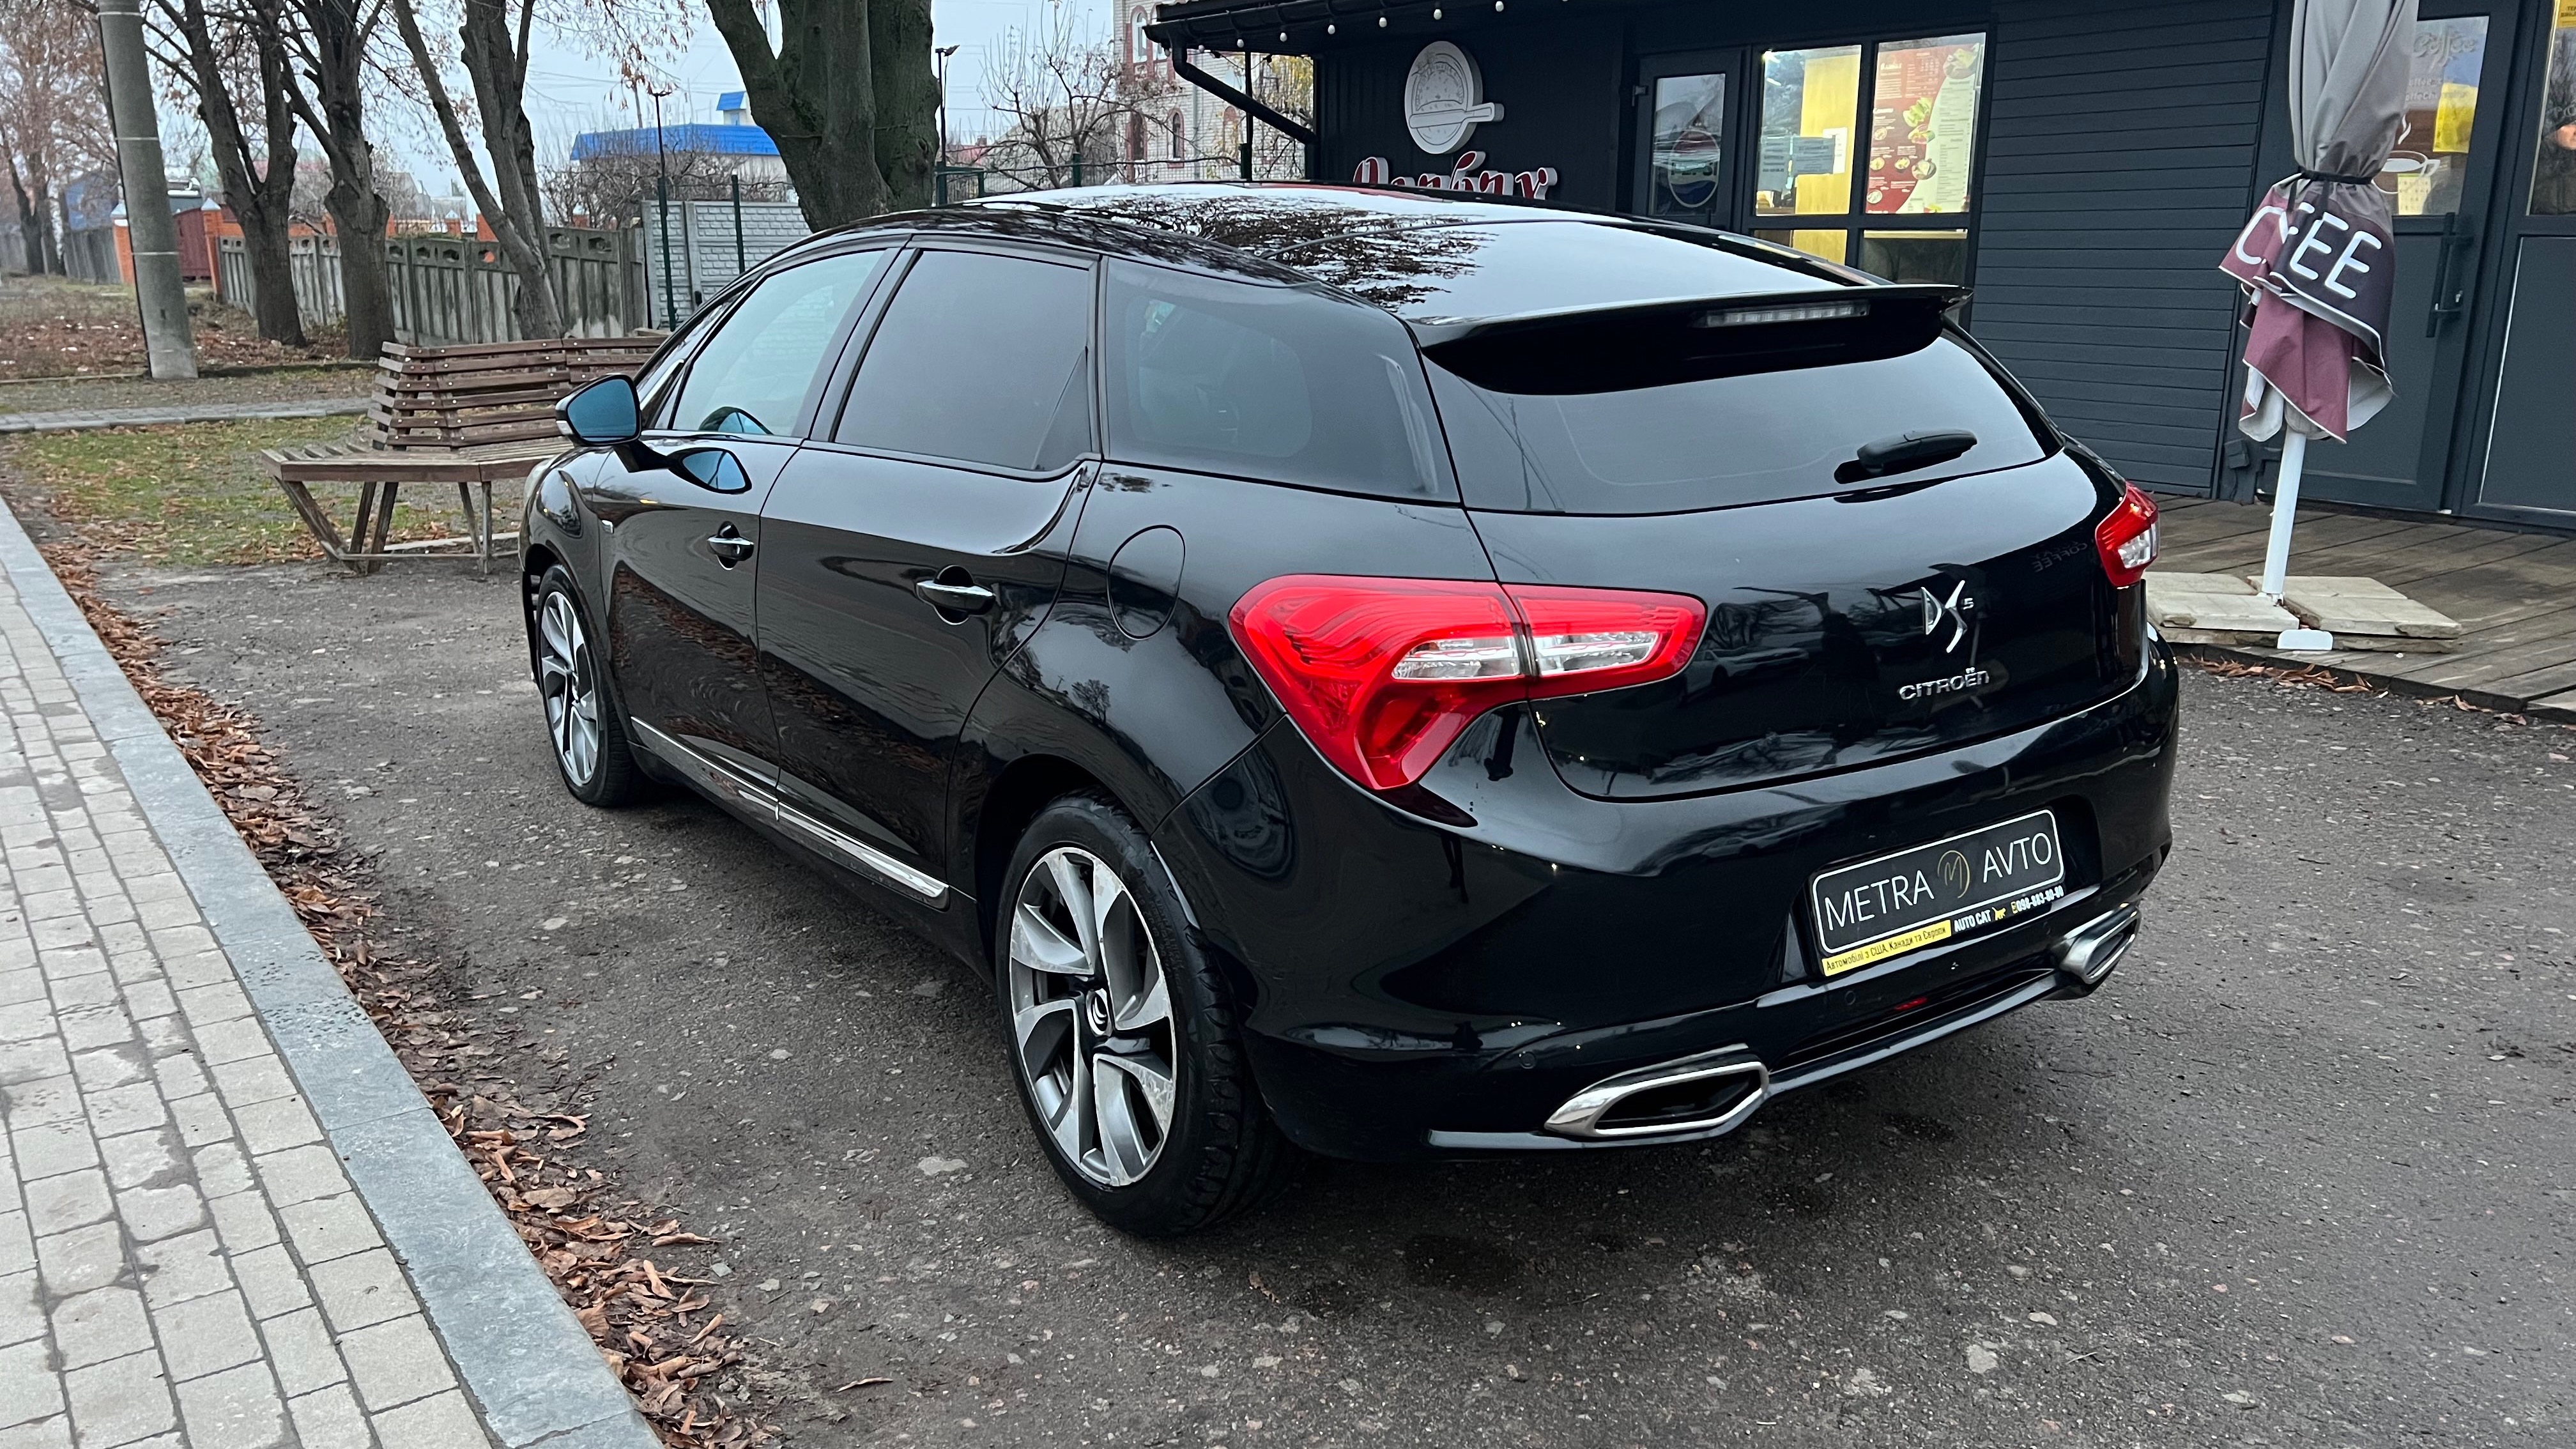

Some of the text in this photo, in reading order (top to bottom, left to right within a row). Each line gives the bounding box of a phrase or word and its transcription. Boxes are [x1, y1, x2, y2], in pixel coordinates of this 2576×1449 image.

[1825, 870, 1934, 931] METRA
[1983, 832, 2053, 884] AVTO
[1954, 915, 1976, 932] AUTO
[1975, 909, 1992, 925] CAT
[1827, 950, 1864, 970] Автомобілі
[1888, 938, 1913, 951] Канади
[1915, 933, 1922, 943] та
